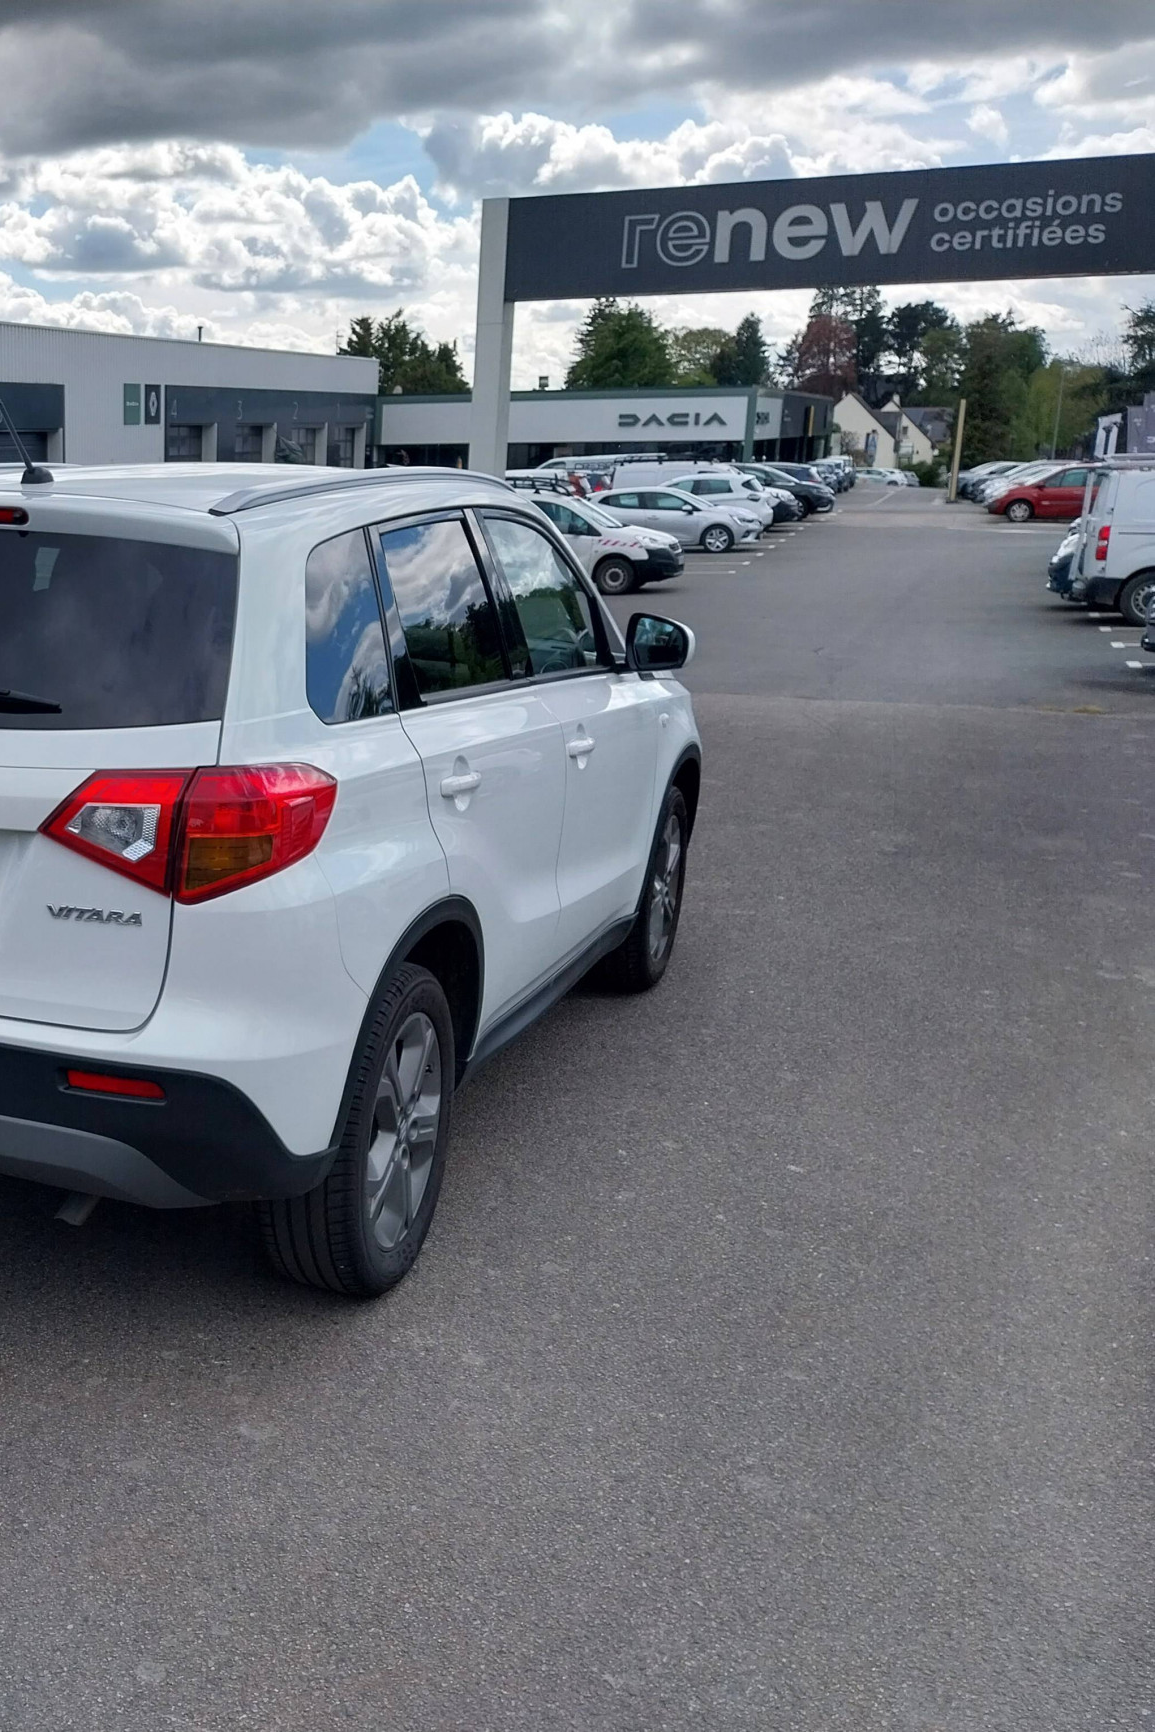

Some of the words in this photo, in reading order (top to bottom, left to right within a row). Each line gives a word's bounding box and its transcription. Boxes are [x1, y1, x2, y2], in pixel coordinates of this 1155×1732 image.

[933, 189, 1124, 223] occasions
[620, 198, 919, 269] renew
[929, 218, 1107, 253] certifiées
[236, 400, 244, 420] 3
[292, 401, 299, 420] 2
[618, 411, 728, 428] DACIA
[46, 903, 143, 927] VITARA
